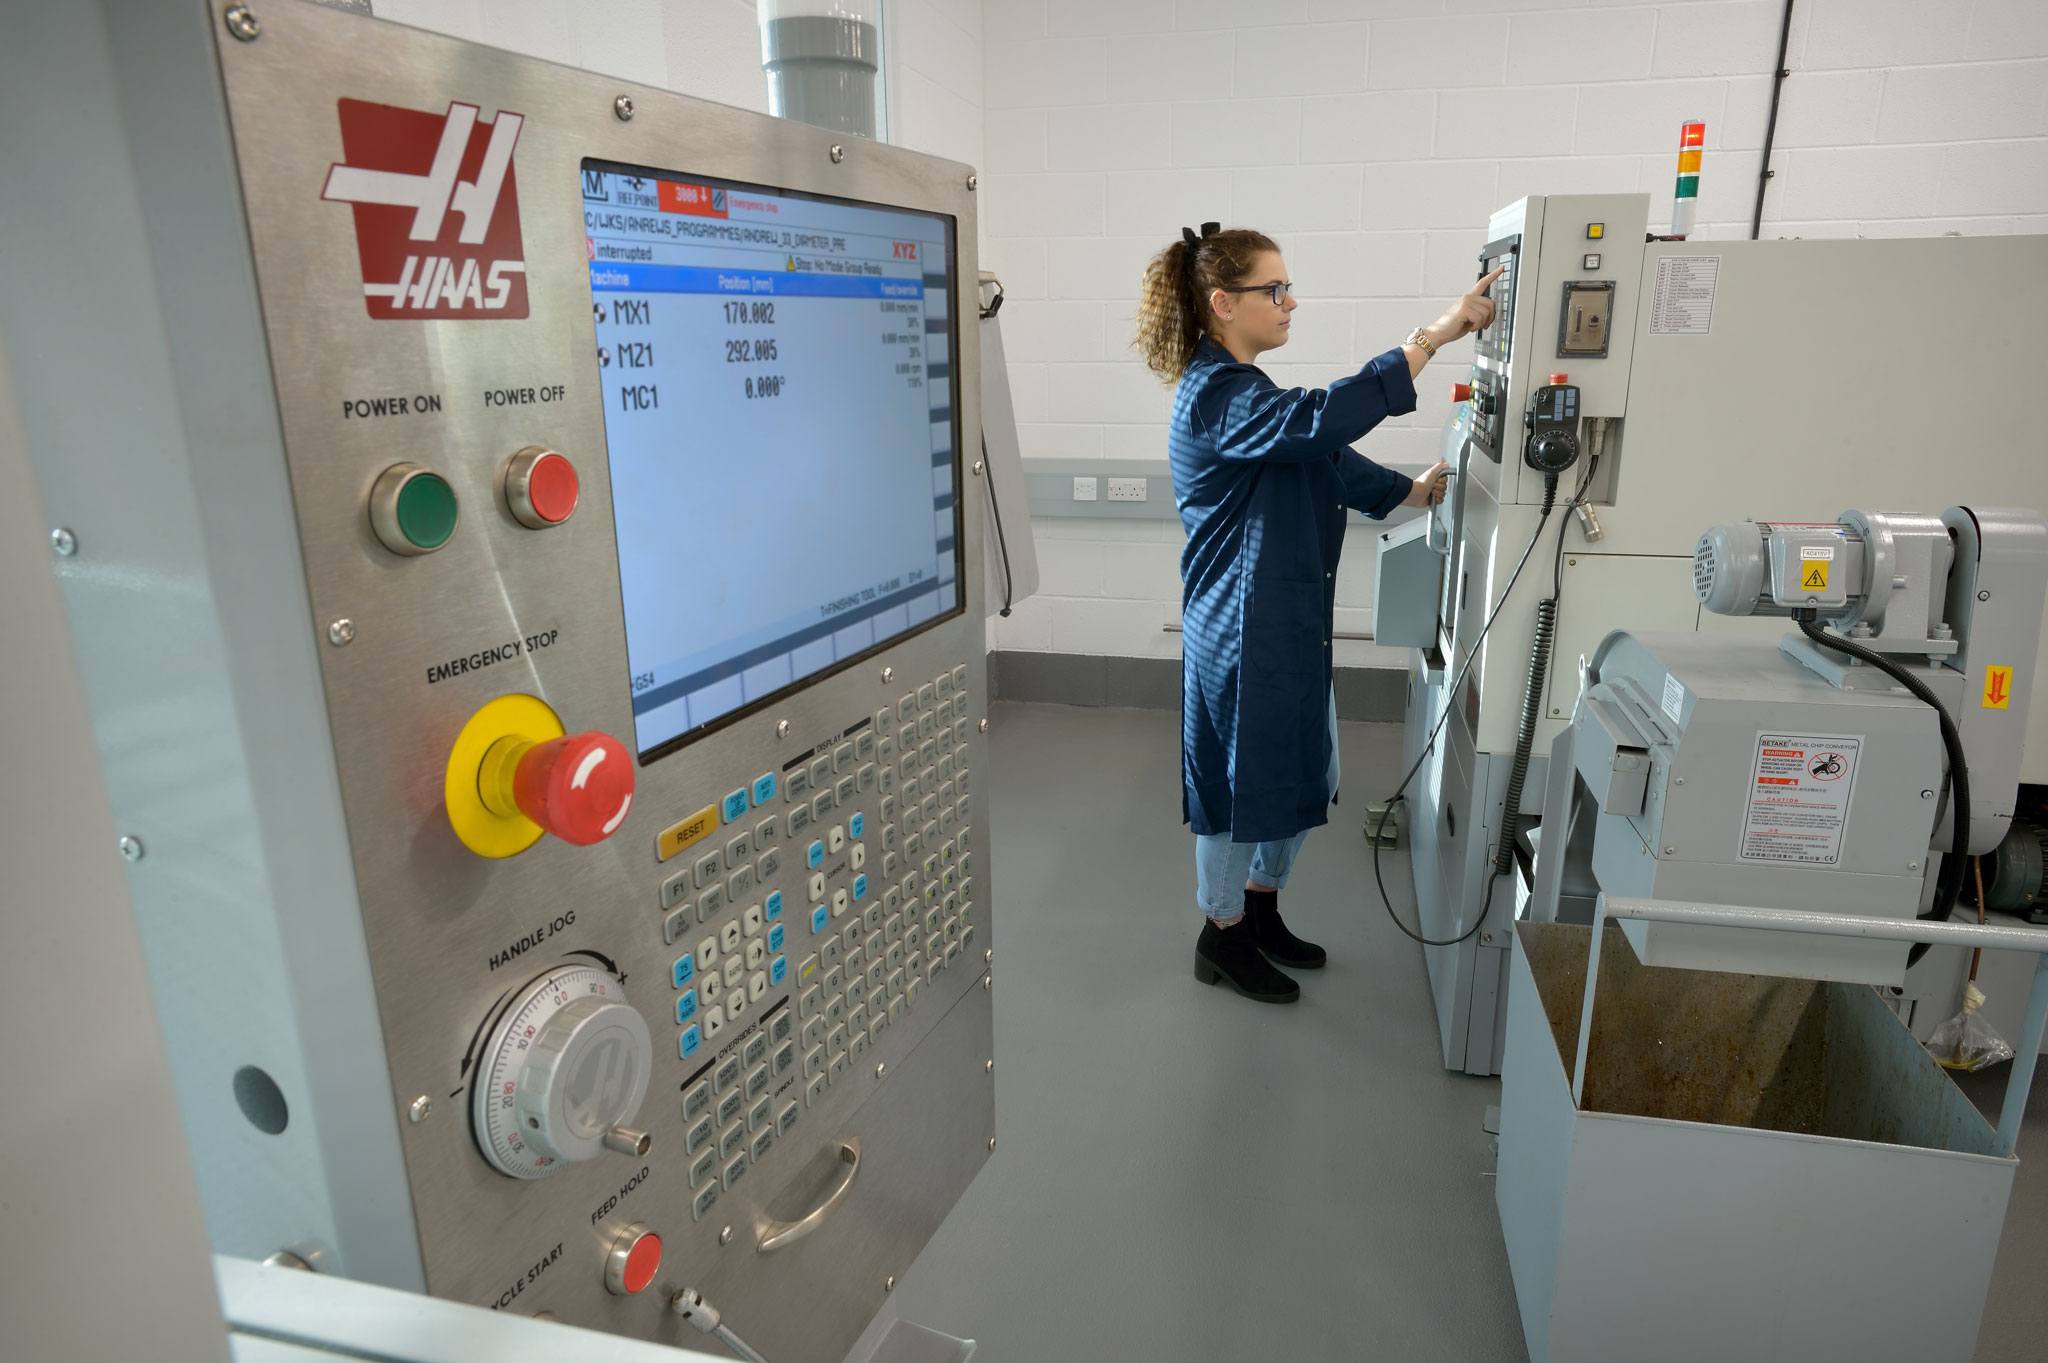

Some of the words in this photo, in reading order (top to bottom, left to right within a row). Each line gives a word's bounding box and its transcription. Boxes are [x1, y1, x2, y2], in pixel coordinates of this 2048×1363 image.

[597, 242, 653, 261] interrupted
[892, 240, 917, 260] XYZ
[363, 255, 526, 309] HAAS
[718, 274, 750, 290] Position
[614, 300, 650, 325] MX1
[723, 302, 775, 324] 170.002
[618, 342, 653, 368] MZ1
[726, 339, 777, 362] 292.005
[344, 398, 408, 419] POWER
[414, 394, 442, 413] ON
[485, 388, 536, 407] POWER
[540, 385, 566, 402] OFF
[622, 385, 658, 411] MC1
[427, 639, 522, 684] EMERGENCY
[525, 629, 559, 652] STOP
[816, 735, 841, 753] DISPLAY
[676, 819, 705, 845] RESET
[763, 826, 774, 840] F4
[735, 843, 747, 857] F3
[705, 861, 717, 877] F2
[672, 883, 684, 897] F1
[489, 928, 545, 971] HANDLE
[547, 910, 577, 938] JOG
[718, 1021, 758, 1059] OVERRIDES
[591, 1195, 618, 1226] FEED
[620, 1166, 649, 1200] HOLD
[491, 1278, 526, 1310] YCLE
[528, 1242, 564, 1284] START
